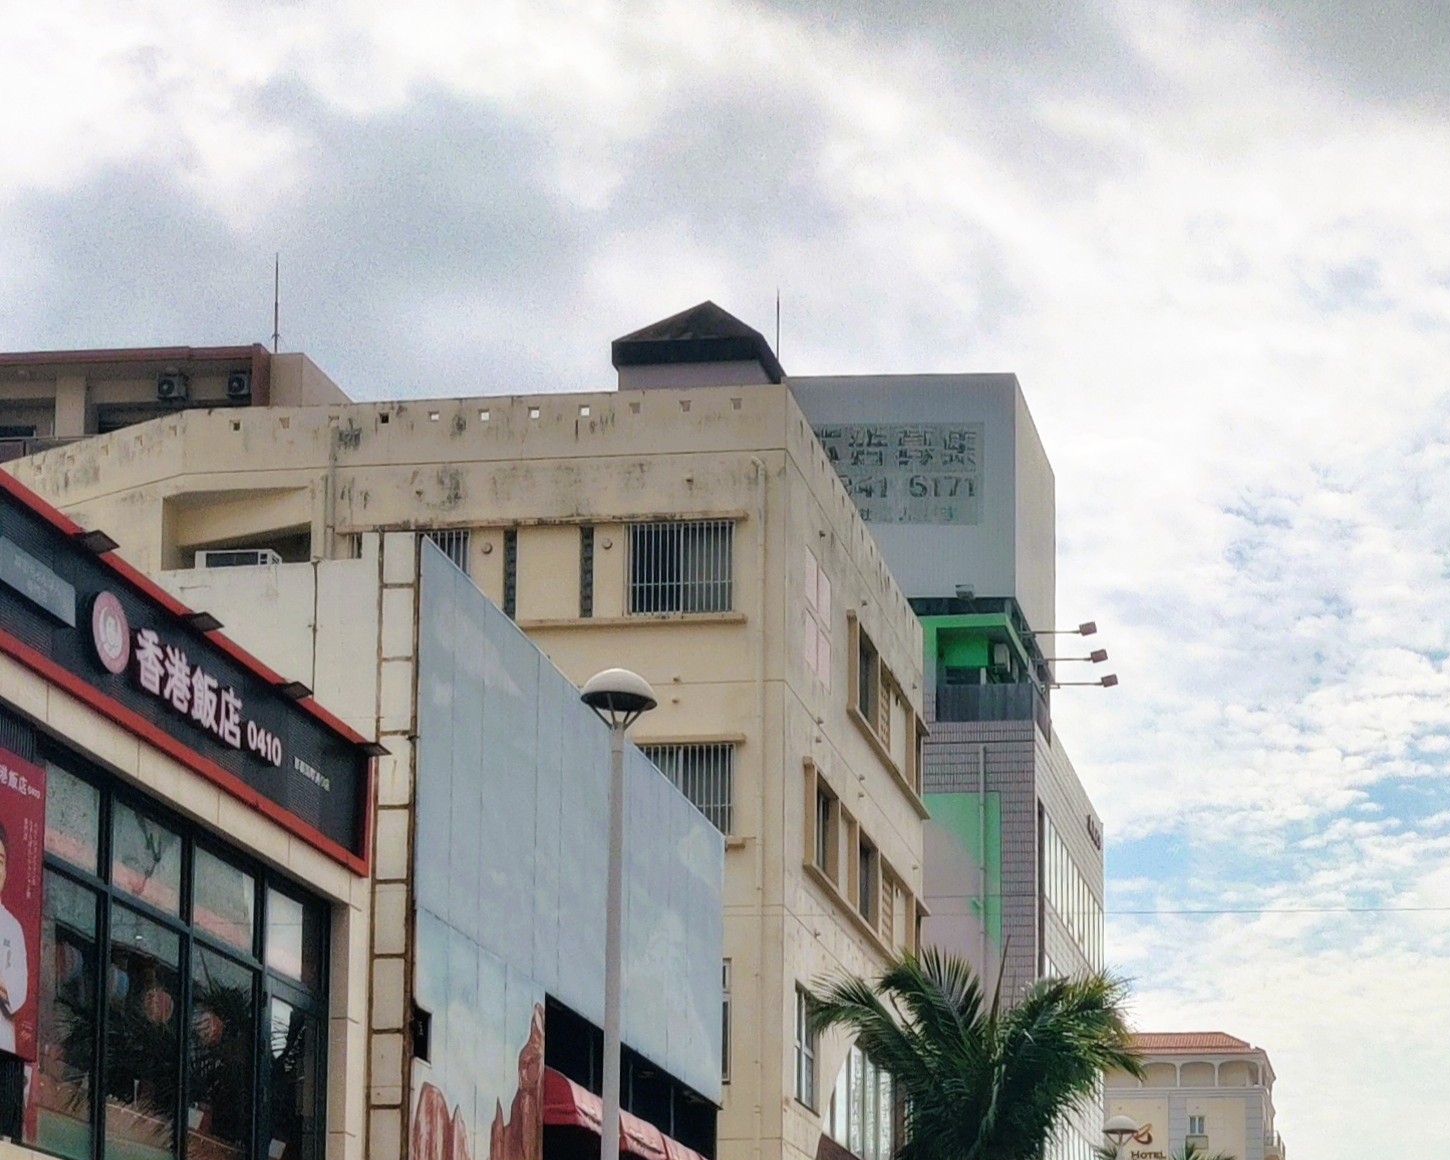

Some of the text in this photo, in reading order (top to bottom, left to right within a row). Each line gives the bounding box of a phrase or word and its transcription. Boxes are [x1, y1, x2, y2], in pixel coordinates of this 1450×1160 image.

[136, 627, 282, 767] 香港飯店 0410
[1131, 1151, 1166, 1159] HOTEL
